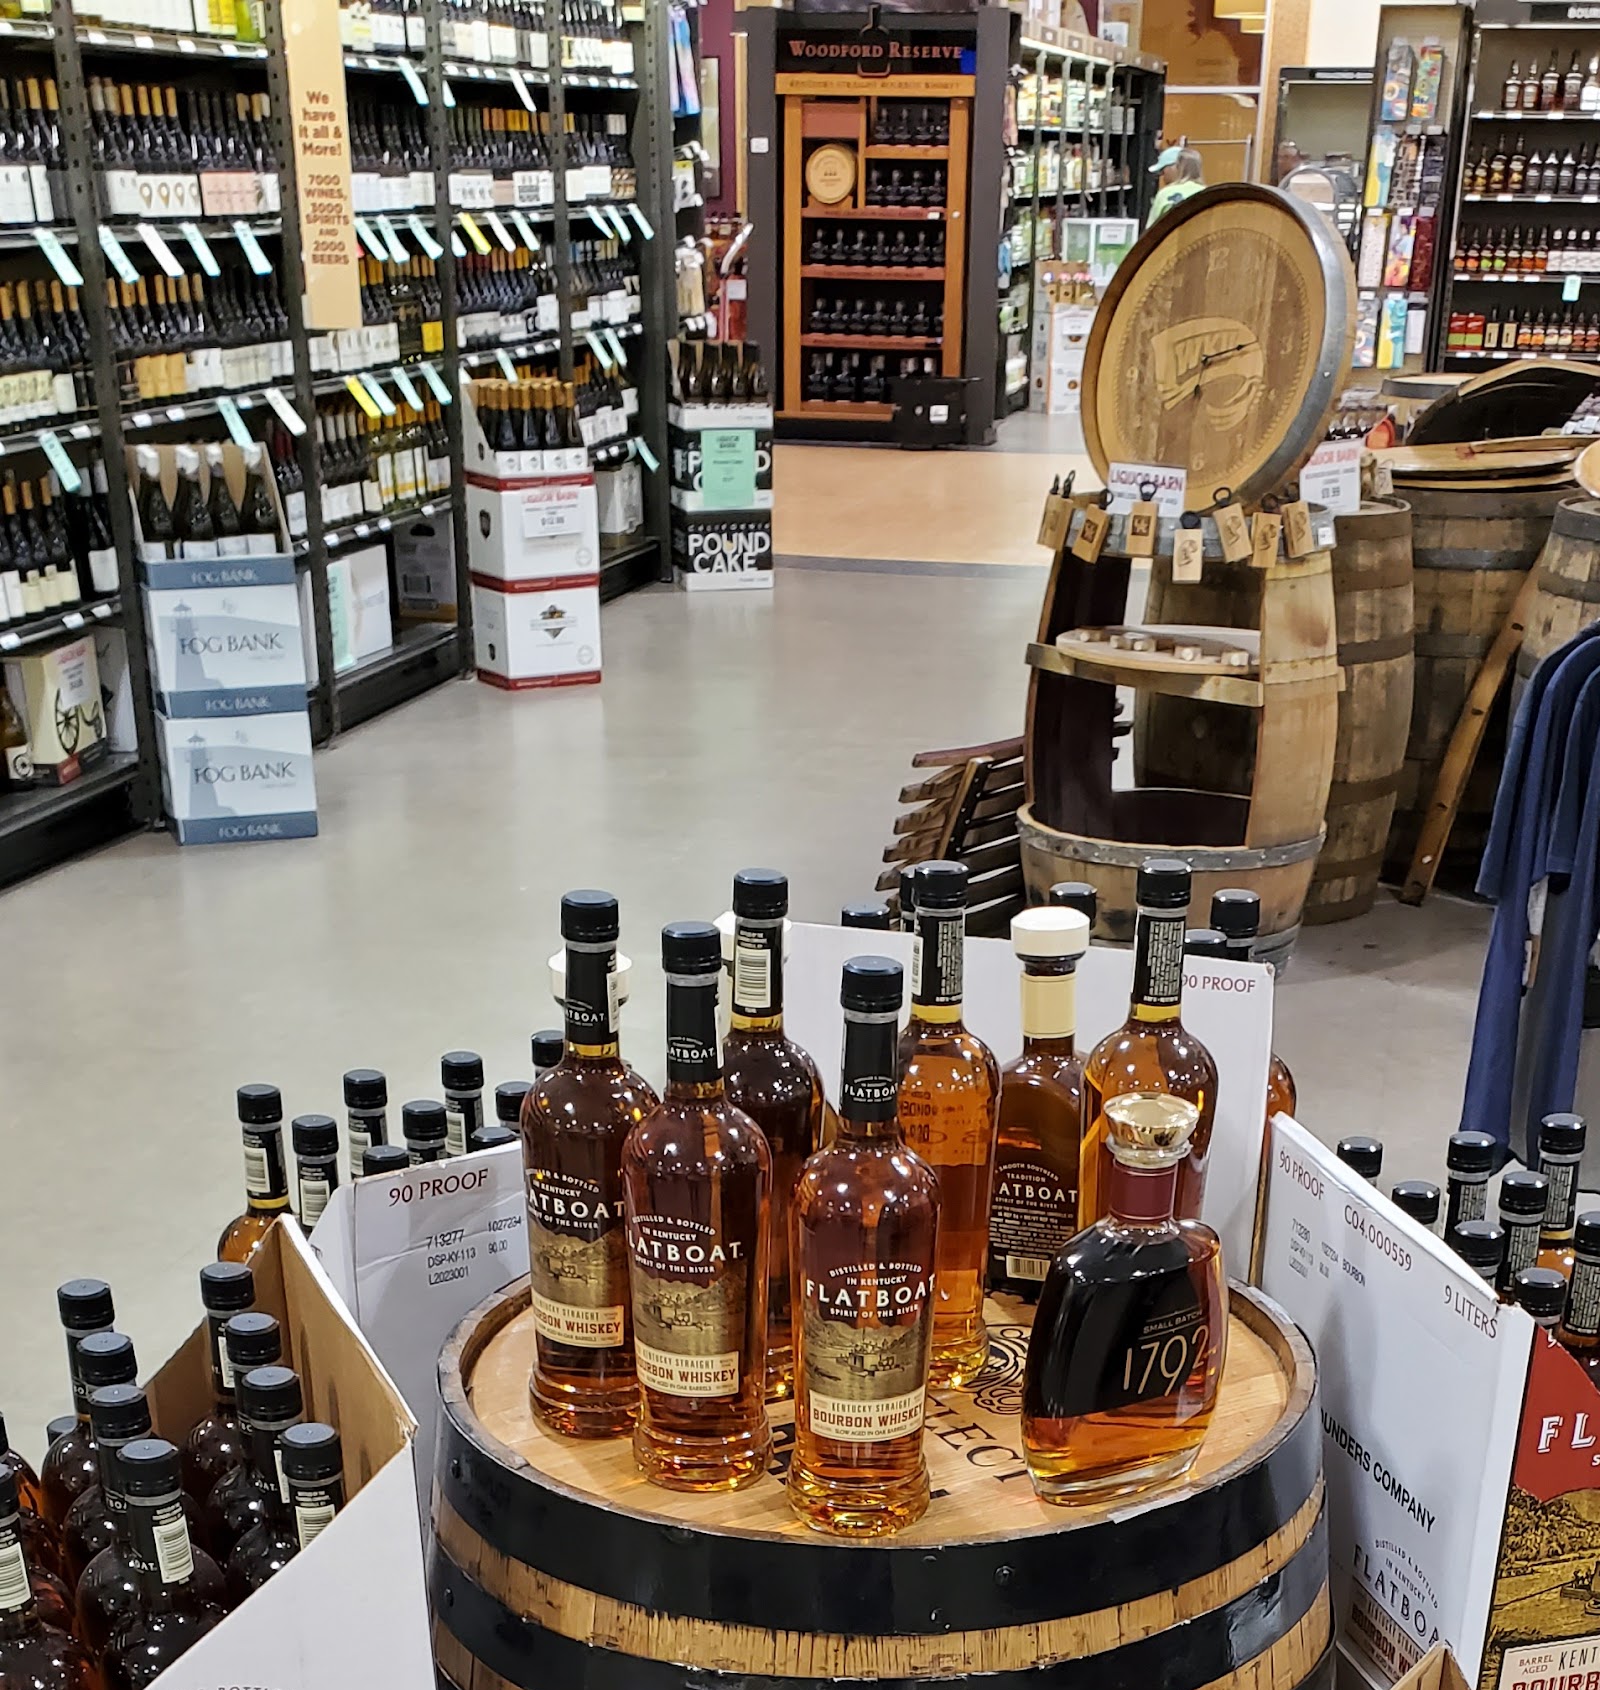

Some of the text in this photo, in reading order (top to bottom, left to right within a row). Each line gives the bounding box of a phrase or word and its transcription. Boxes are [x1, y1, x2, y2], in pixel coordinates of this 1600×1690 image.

[789, 41, 963, 58] WOODFORD RESERVE
[306, 91, 329, 104] We
[302, 108, 335, 121] have
[299, 125, 342, 139] it all &
[302, 142, 342, 156] More!
[308, 174, 340, 186] 7000
[304, 188, 347, 201] WINES,
[306, 214, 349, 225] SPIRITS
[319, 228, 338, 236] AND
[313, 241, 345, 252] 2000
[312, 254, 349, 265] BEERS
[688, 531, 770, 556] POUND
[693, 552, 758, 574] CAKE
[180, 633, 284, 655] FOG BANK
[194, 761, 296, 784] FOG BANK
[1202, 976, 1256, 992] PROOF
[1280, 1151, 1324, 1200] 90 PROOF
[389, 1168, 489, 1207] 90 PROOF
[829, 1263, 875, 1277] DISTILLED
[889, 1263, 922, 1273] BOTTLED
[847, 1275, 907, 1286] IN KENTUCKY
[806, 1273, 935, 1307] FLATBOAT
[830, 1308, 858, 1318] SPIRIT
[897, 1304, 918, 1315] RIVER
[1444, 1285, 1498, 1339] 9 LITERS
[1143, 1310, 1202, 1334] SMALL BATCH
[1123, 1324, 1210, 1397] 1792
[813, 1407, 872, 1428] BOURBON
[1373, 1461, 1436, 1534] COMPANY
[1519, 1655, 1553, 1667] BARREL
[1522, 1664, 1548, 1674] AGED
